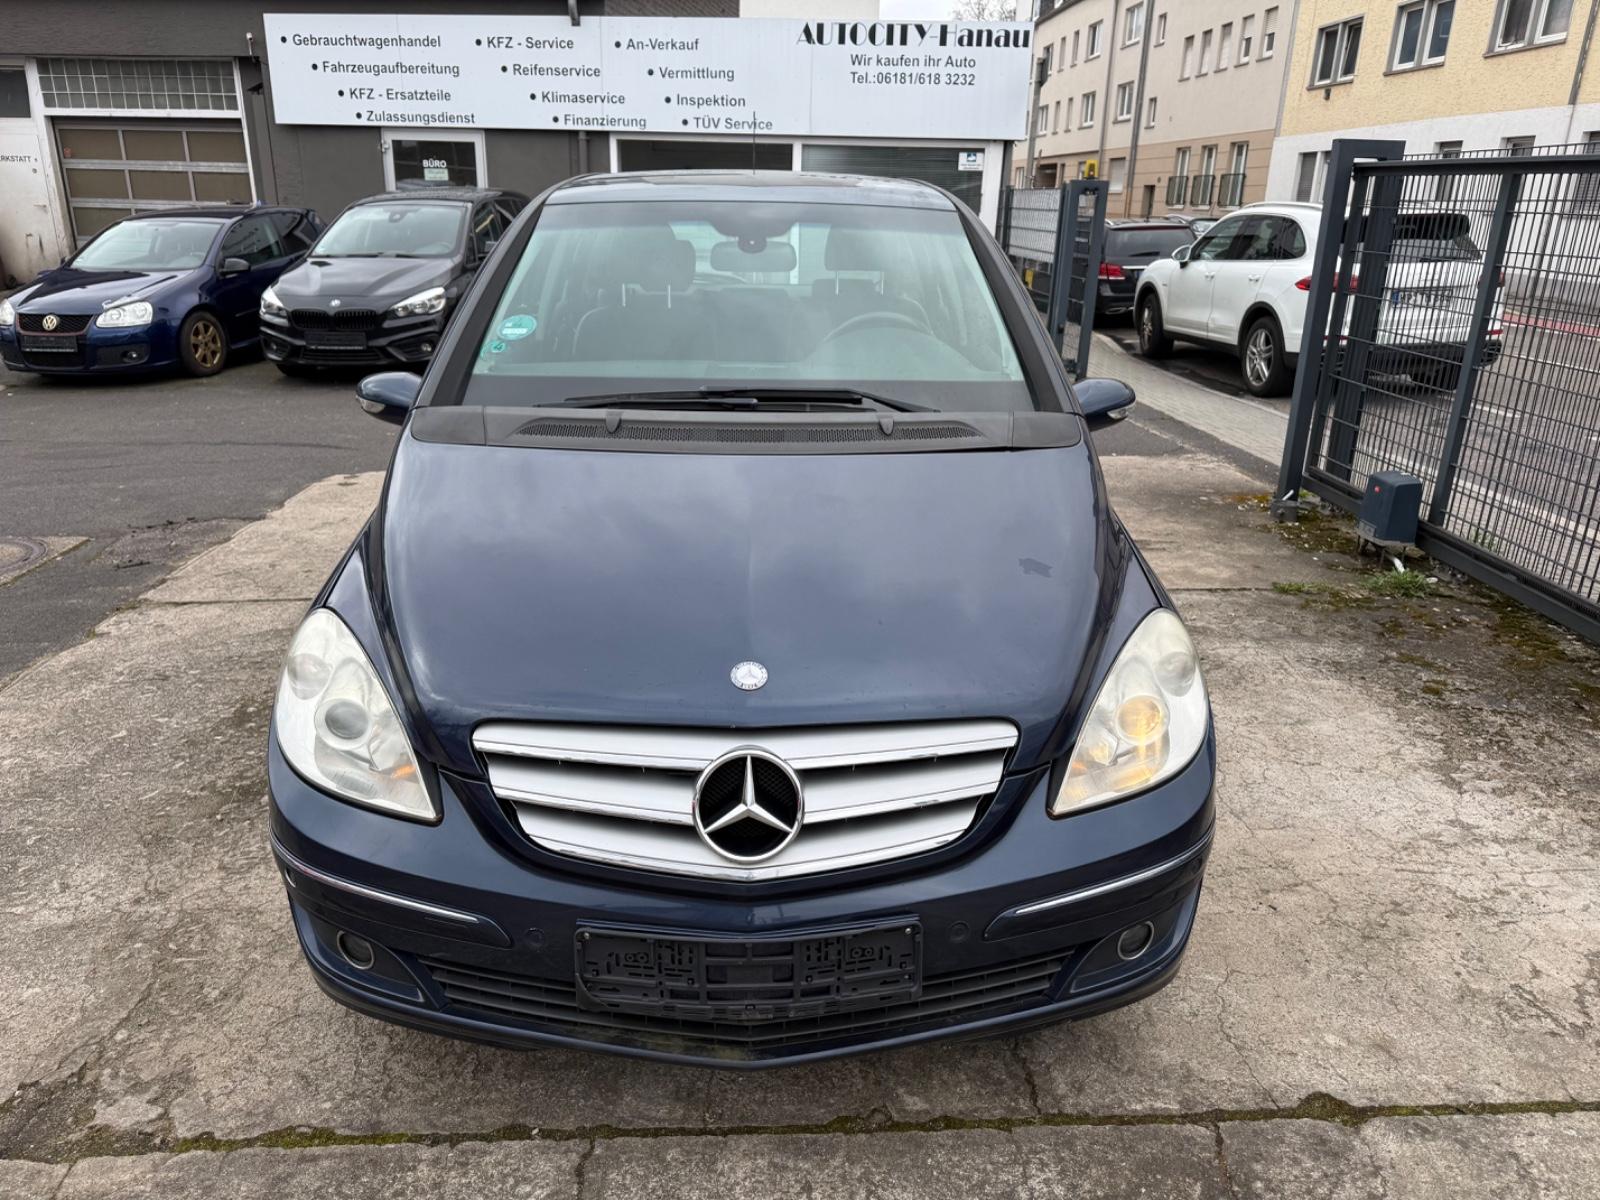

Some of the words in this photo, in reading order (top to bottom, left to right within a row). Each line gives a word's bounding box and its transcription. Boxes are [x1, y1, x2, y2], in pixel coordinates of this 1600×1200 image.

[292, 34, 441, 51] Gebrauchtwagenhandel
[487, 36, 514, 48] KFZ
[525, 37, 574, 49] Service
[797, 22, 1030, 49] AUTOCITY-Hanau
[626, 38, 699, 50] An-Verkauf
[850, 54, 873, 66] Wir
[876, 54, 919, 67] kaufen
[924, 55, 941, 67] ihr
[945, 56, 976, 68] Auto
[322, 61, 460, 77] Fahrzeugaufbereitung
[513, 64, 600, 77] Reifenservice
[659, 67, 735, 82] Vermittlung
[945, 73, 976, 86] 3232
[349, 88, 375, 100] KFZ
[386, 88, 451, 101] Ersatzteile
[541, 91, 625, 104] Klimaservice
[677, 94, 746, 109] Inspektion
[366, 110, 475, 125] Zulassungsdienst
[564, 114, 647, 130] Finanzierung
[693, 115, 720, 129] TÜV
[724, 117, 773, 130] Service
[423, 158, 447, 168] BÜRO
